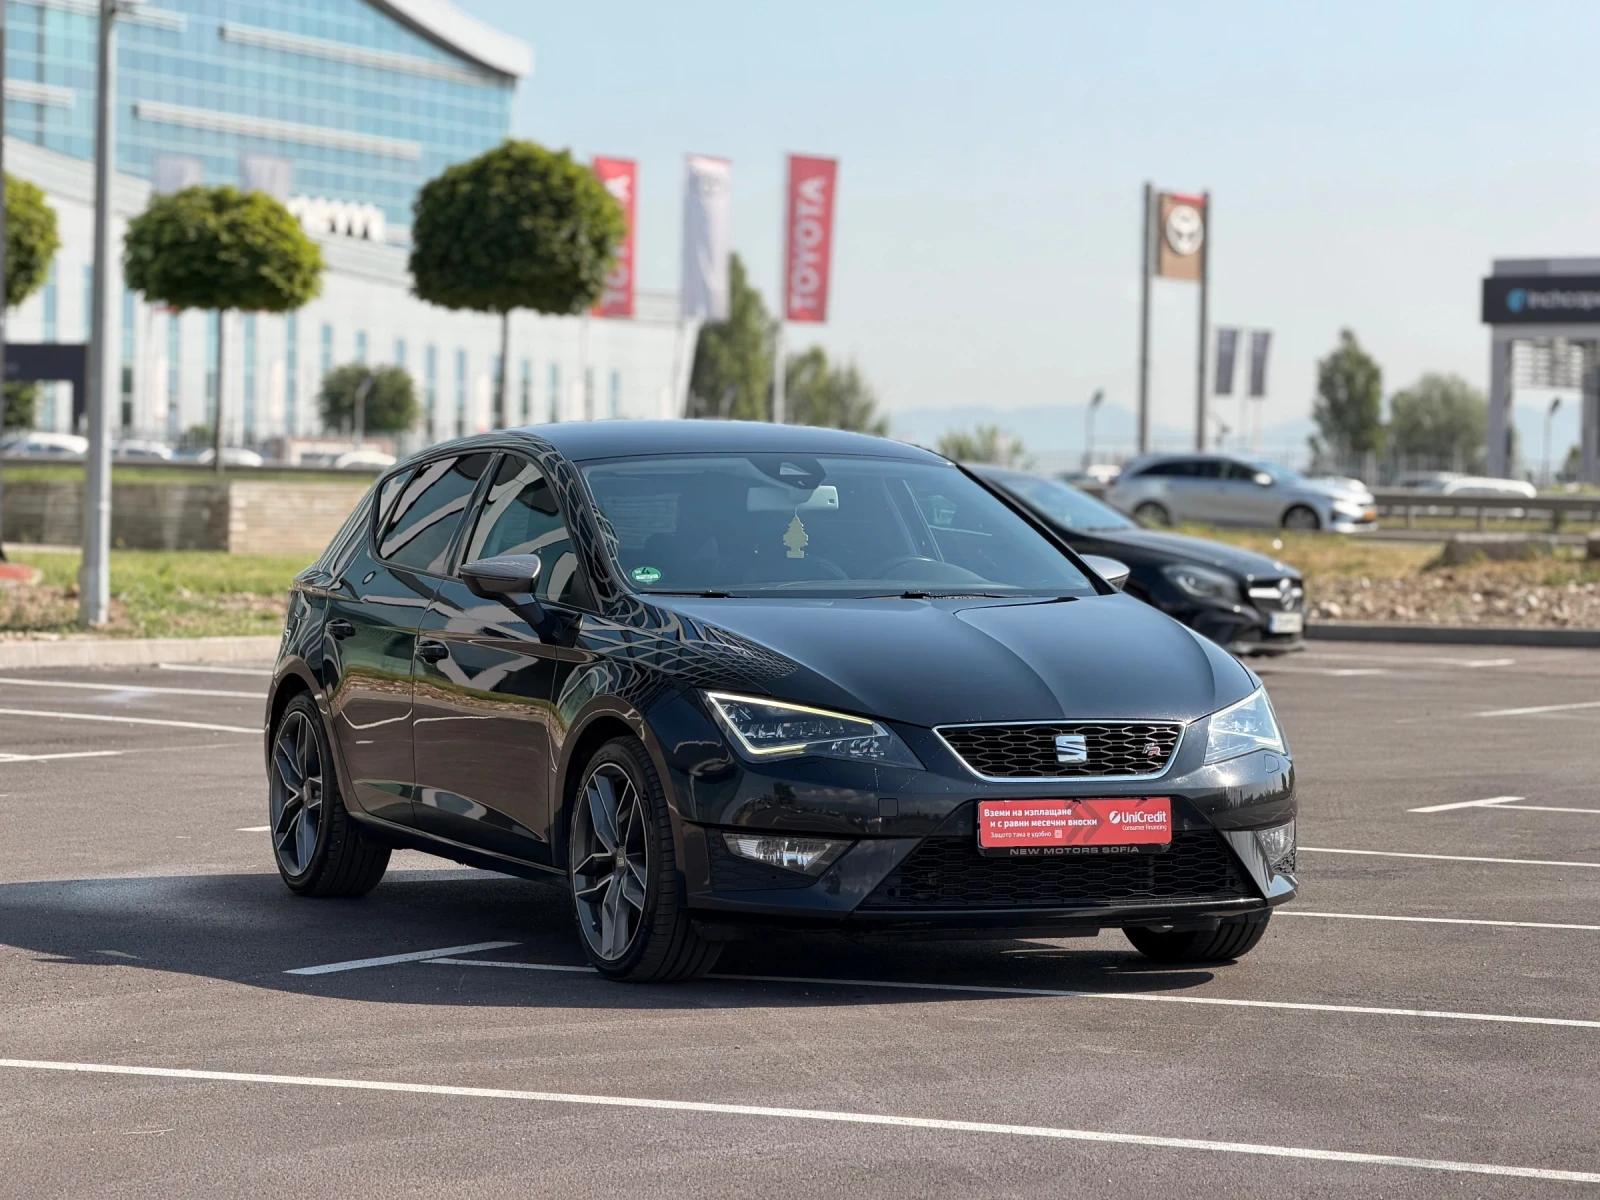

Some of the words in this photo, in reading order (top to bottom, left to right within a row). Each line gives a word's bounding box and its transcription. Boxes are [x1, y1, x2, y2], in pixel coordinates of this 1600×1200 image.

[791, 177, 825, 309] TOYOTA
[984, 808, 1011, 817] Вземи
[1012, 808, 1023, 817] на
[1024, 808, 1072, 817] изплащане
[1121, 810, 1167, 823] UniCredit
[1004, 820, 1030, 829] равни
[1031, 819, 1067, 828] месечни
[1145, 824, 1167, 832] Financing
[991, 831, 1013, 839] Защото
[1031, 830, 1052, 839] удобно
[1010, 848, 1040, 856] NEW
[1043, 847, 1098, 855] MOTORS
